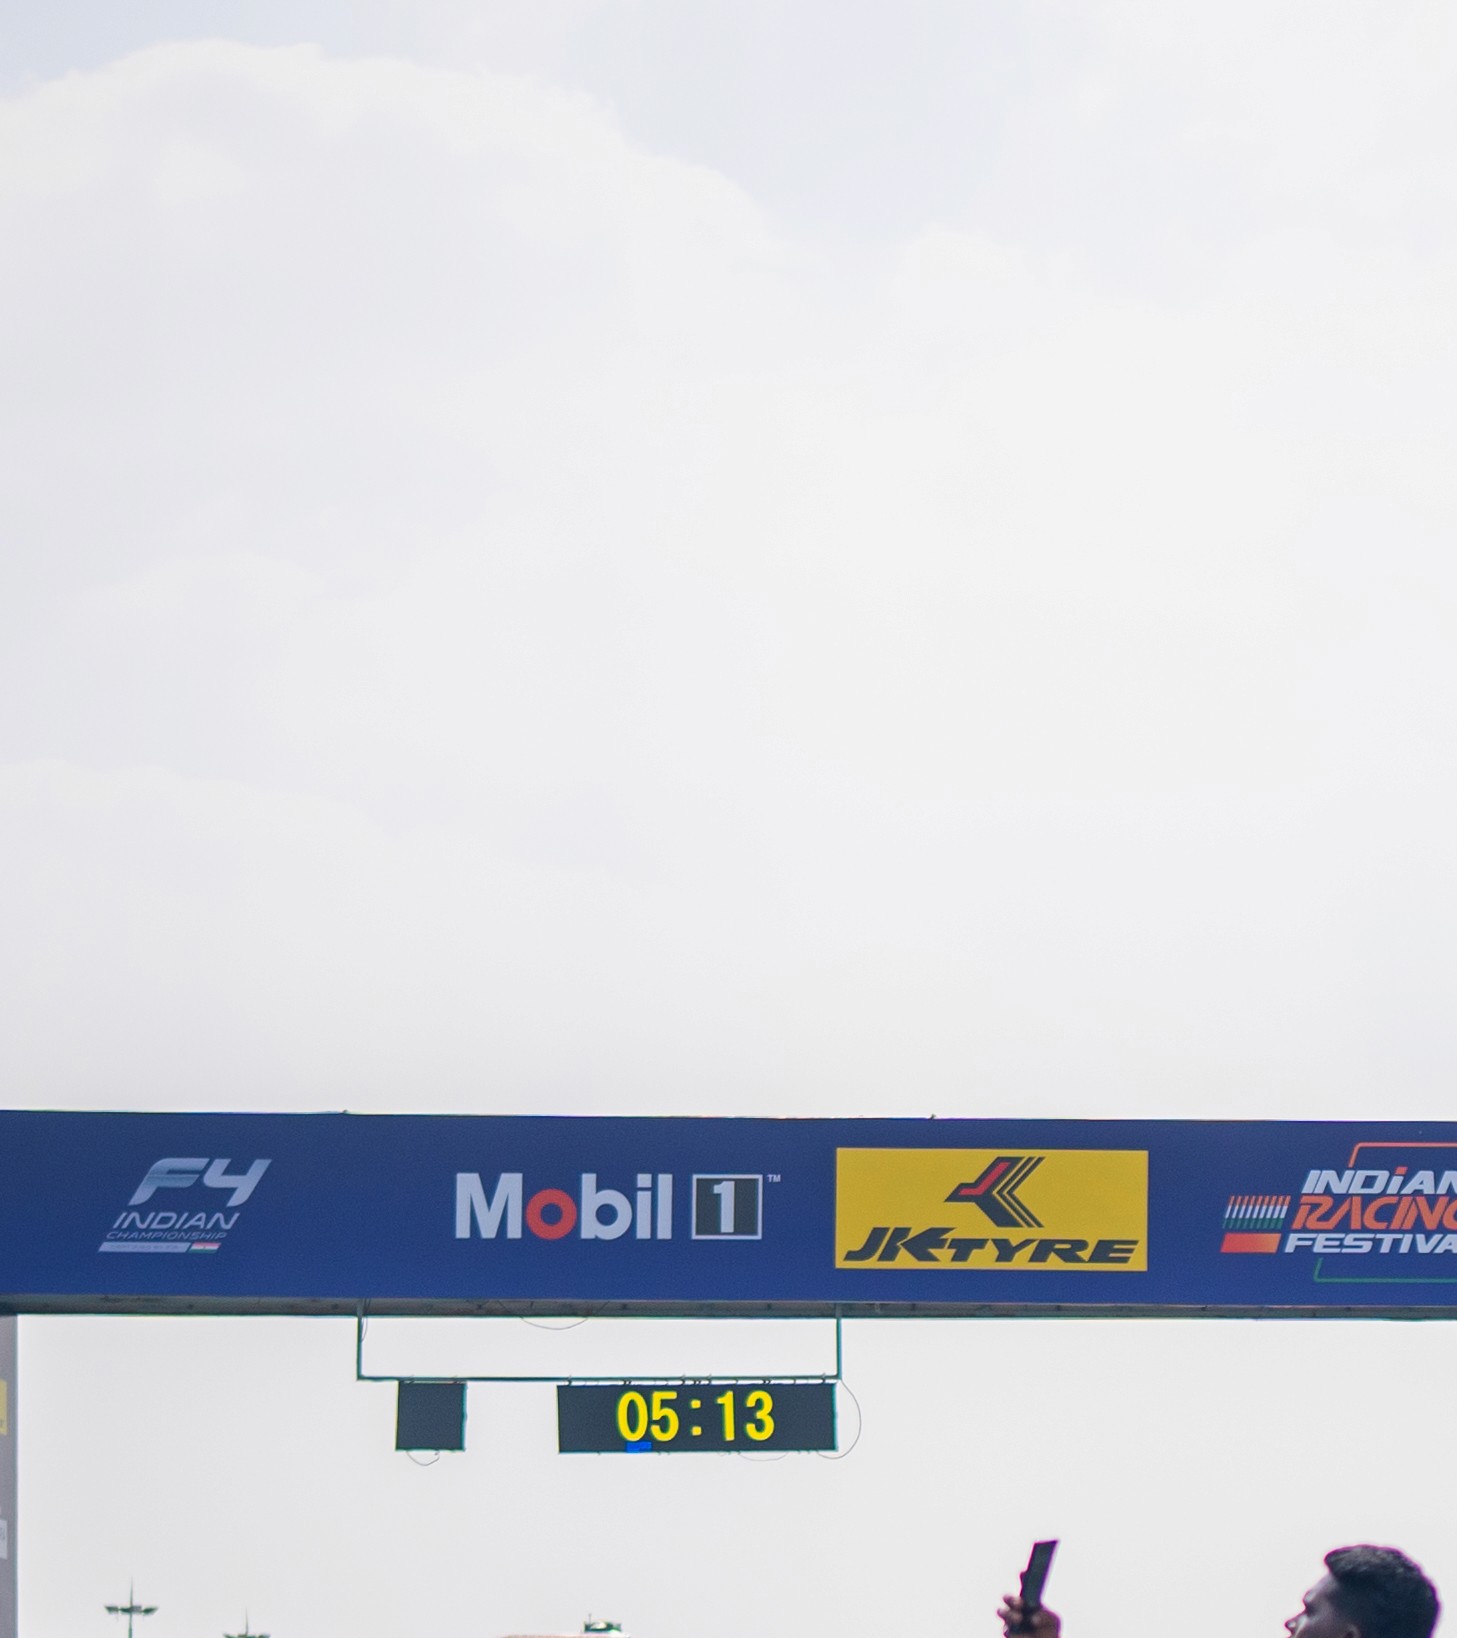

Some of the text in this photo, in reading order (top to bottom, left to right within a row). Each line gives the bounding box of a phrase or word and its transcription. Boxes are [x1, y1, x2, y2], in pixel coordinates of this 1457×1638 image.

[128, 1158, 272, 1207] F4
[455, 1173, 672, 1240] Mobil
[710, 1179, 737, 1233] 1
[106, 1231, 227, 1240] CHAMPIONSHIP
[113, 1212, 240, 1229] INDIAN
[616, 1390, 775, 1441] 05:13
